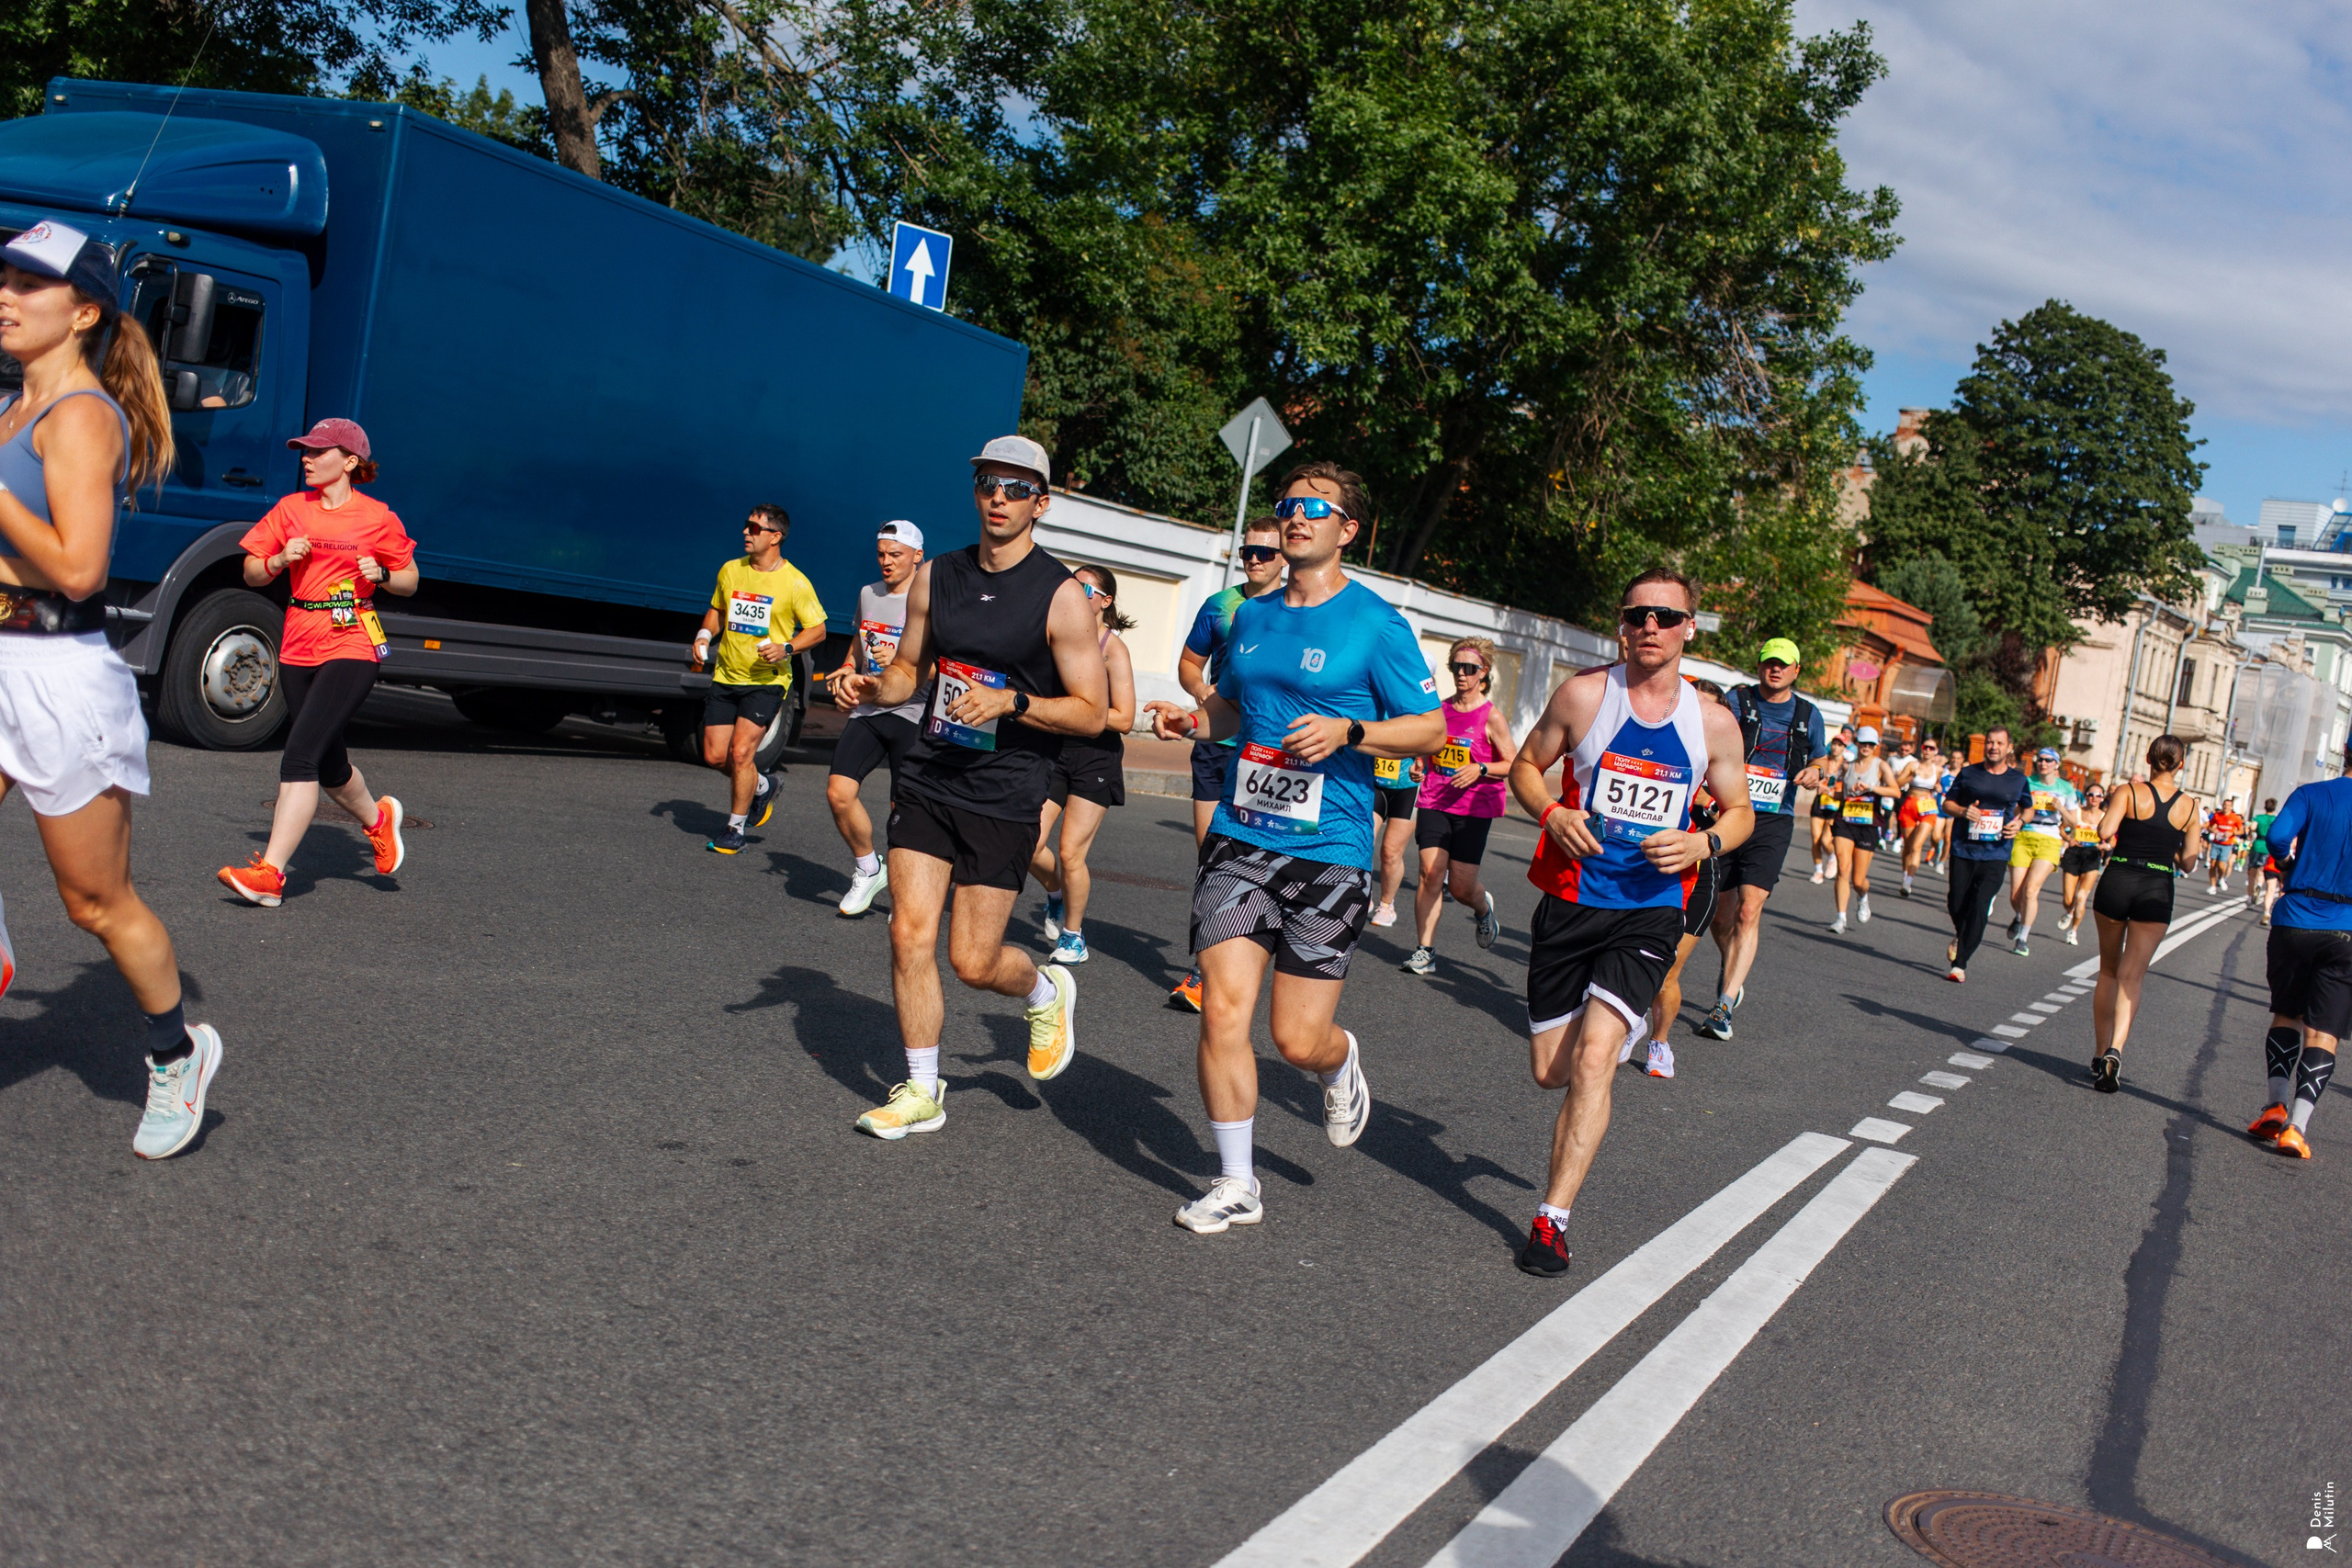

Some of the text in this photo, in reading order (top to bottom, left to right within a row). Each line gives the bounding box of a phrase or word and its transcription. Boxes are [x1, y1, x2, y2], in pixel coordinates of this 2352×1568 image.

[236, 296, 258, 305] ATEGO
[323, 543, 358, 551] RELIGION
[734, 603, 765, 619] 3435
[730, 623, 737, 631] D
[379, 645, 388, 656] D
[1300, 648, 1326, 673] 10
[971, 671, 983, 681] 21,1
[933, 719, 942, 734] D
[1250, 750, 1274, 761] МАРАФОН
[1284, 757, 1298, 767] 21,1
[1613, 761, 1643, 772] МАРАФОН
[1655, 768, 1668, 777] 21,1
[1246, 770, 1309, 804] 6423
[1747, 777, 1780, 795] 2704
[1607, 777, 1674, 814] 5121
[1257, 798, 1291, 812] МИХАИЛ
[1239, 808, 1249, 824] D
[1611, 806, 1663, 822] ВЛАДИСЛАВ
[1974, 820, 1998, 830] 7574
